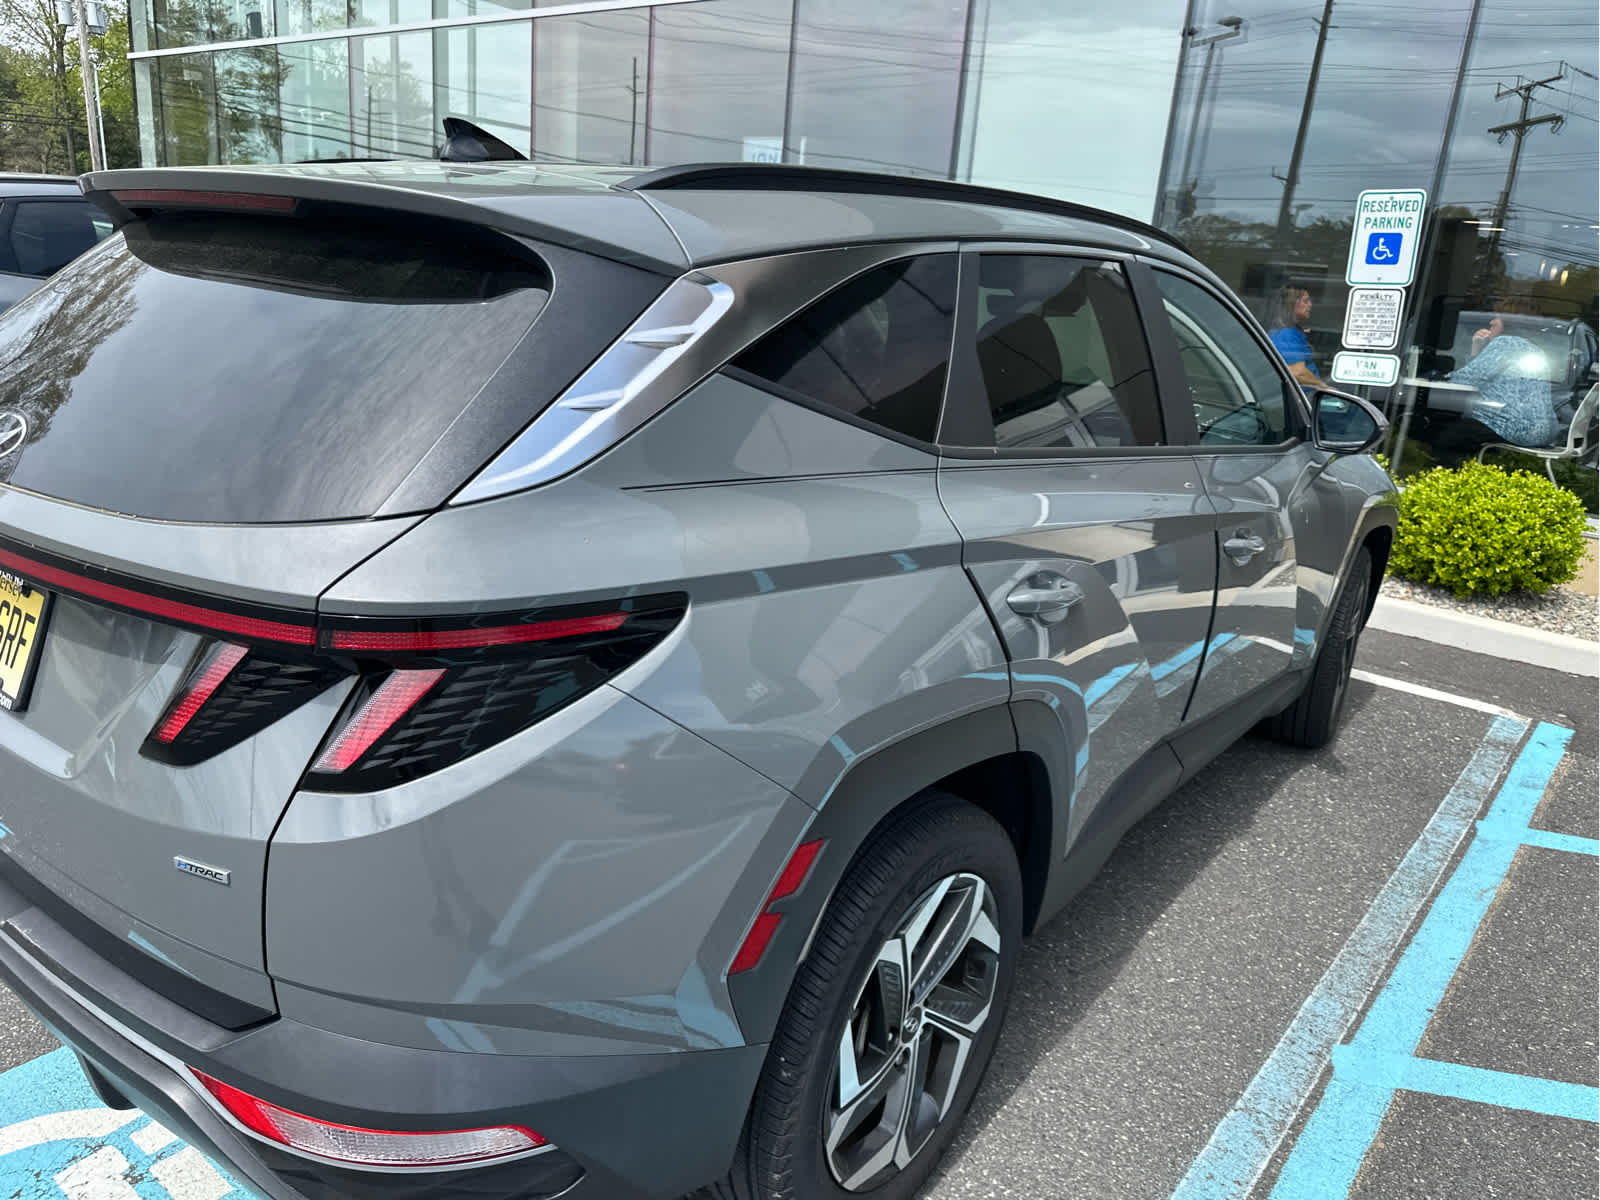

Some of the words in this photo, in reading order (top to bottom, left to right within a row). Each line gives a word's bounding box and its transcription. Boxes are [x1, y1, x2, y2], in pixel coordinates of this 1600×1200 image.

[1363, 200, 1419, 213] RESERVED
[1364, 217, 1413, 229] PARKING
[1360, 293, 1393, 301] PENALTY
[177, 860, 224, 881] HTRAC
